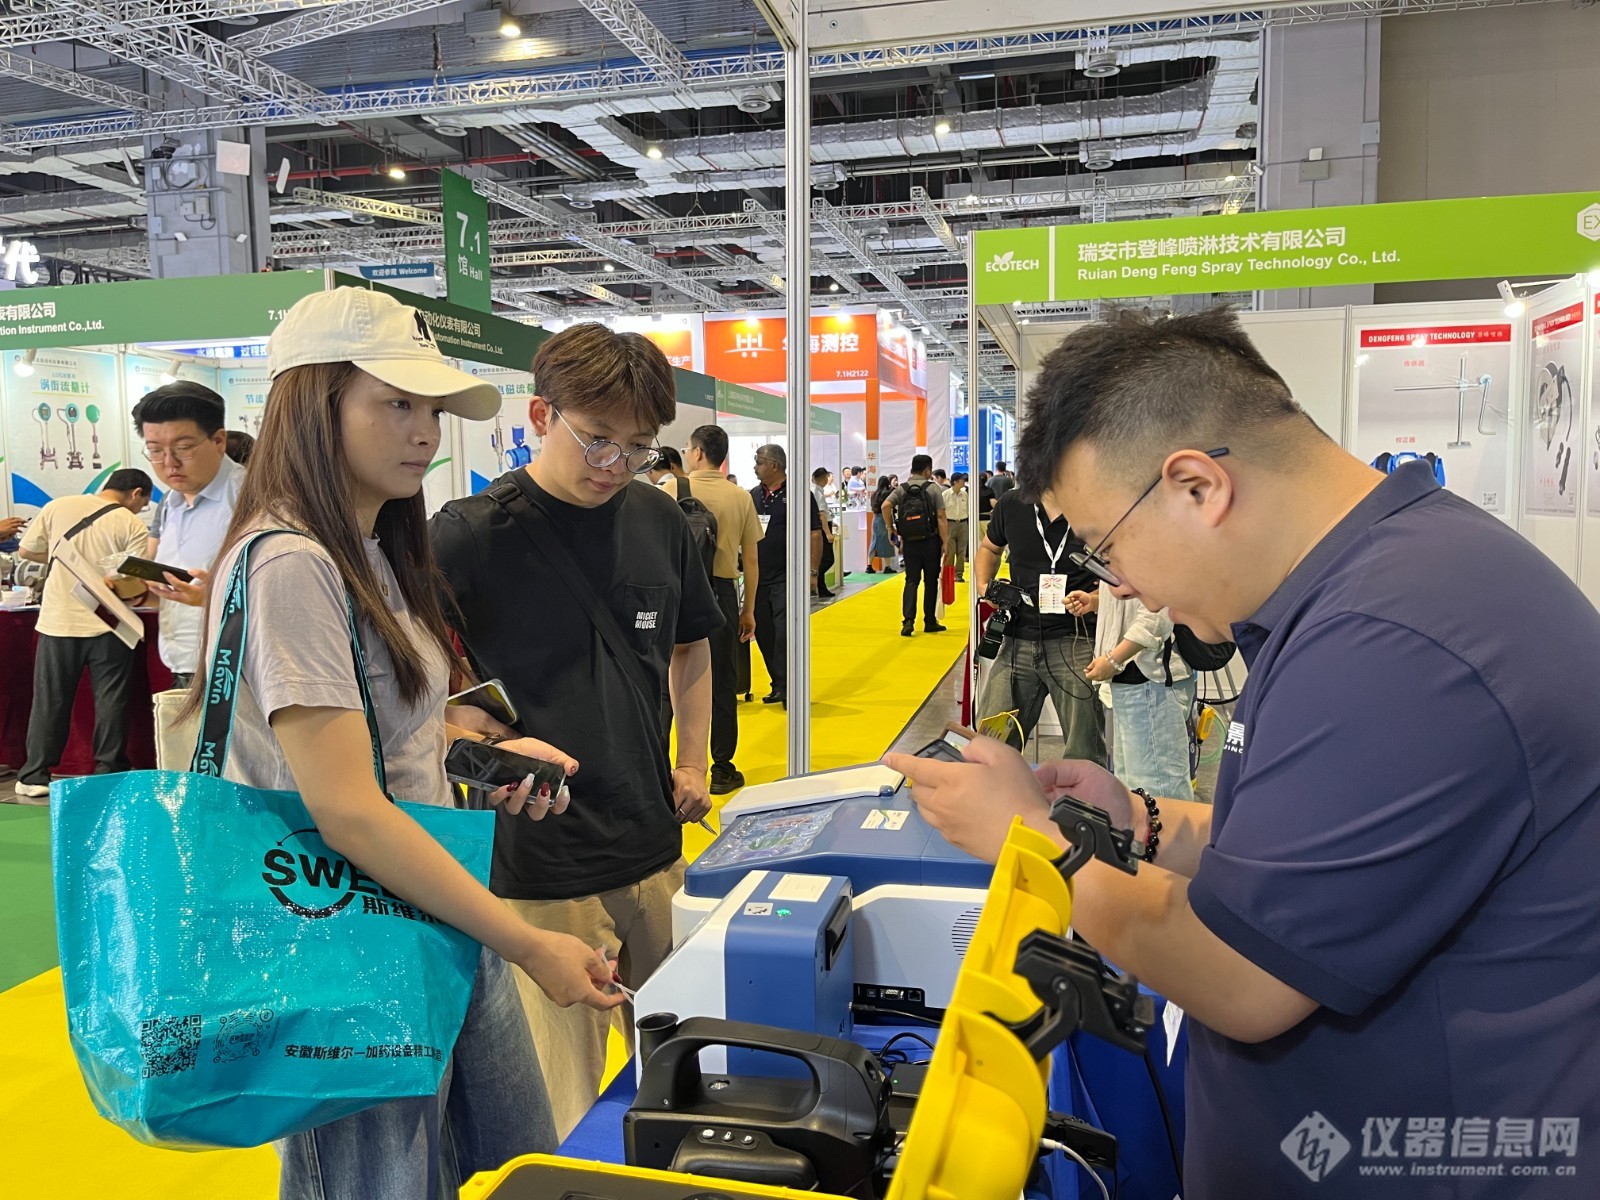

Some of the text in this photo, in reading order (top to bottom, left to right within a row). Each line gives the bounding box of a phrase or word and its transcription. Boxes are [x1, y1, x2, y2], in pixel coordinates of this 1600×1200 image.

[1078, 226, 1346, 263] 瑞安市登峰喷淋技术有限公司
[399, 267, 428, 275] Welcome
[457, 254, 483, 281] 馆 Hall
[985, 259, 1039, 273] ECOTECH
[1078, 250, 1401, 281] Ruian Deng Feng Spray Technology Co., Ltd.
[18, 322, 67, 335] Instrument
[432, 332, 460, 345] utomation
[460, 337, 486, 351] Instrument
[1368, 334, 1405, 343] DENGFENG
[1429, 331, 1475, 340] TECHNOLOGY
[836, 369, 869, 378] 7.1H2122
[636, 611, 658, 620] MICKEY
[634, 619, 657, 629] MOUSE
[211, 649, 232, 705] Mavin
[261, 848, 404, 900] SWE
